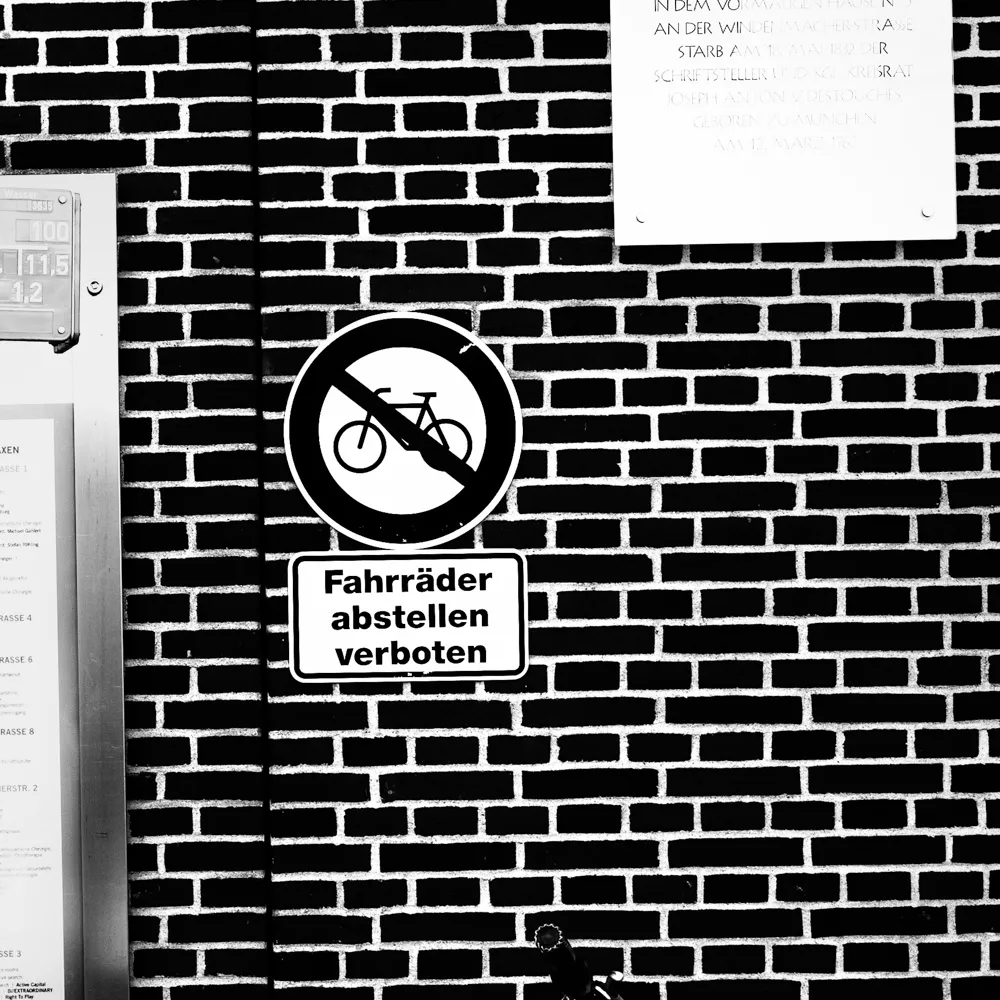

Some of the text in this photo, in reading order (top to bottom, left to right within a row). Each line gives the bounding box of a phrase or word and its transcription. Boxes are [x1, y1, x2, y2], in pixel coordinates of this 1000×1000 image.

[674, 0, 711, 12] DEM
[653, 21, 682, 36] AN
[685, 20, 713, 35] DER
[677, 44, 724, 59] STARB
[728, 43, 762, 57] AM
[32, 220, 69, 241] 100
[325, 567, 493, 594] Fahrräder
[331, 603, 489, 630] abstellen
[335, 640, 488, 666] verboten
